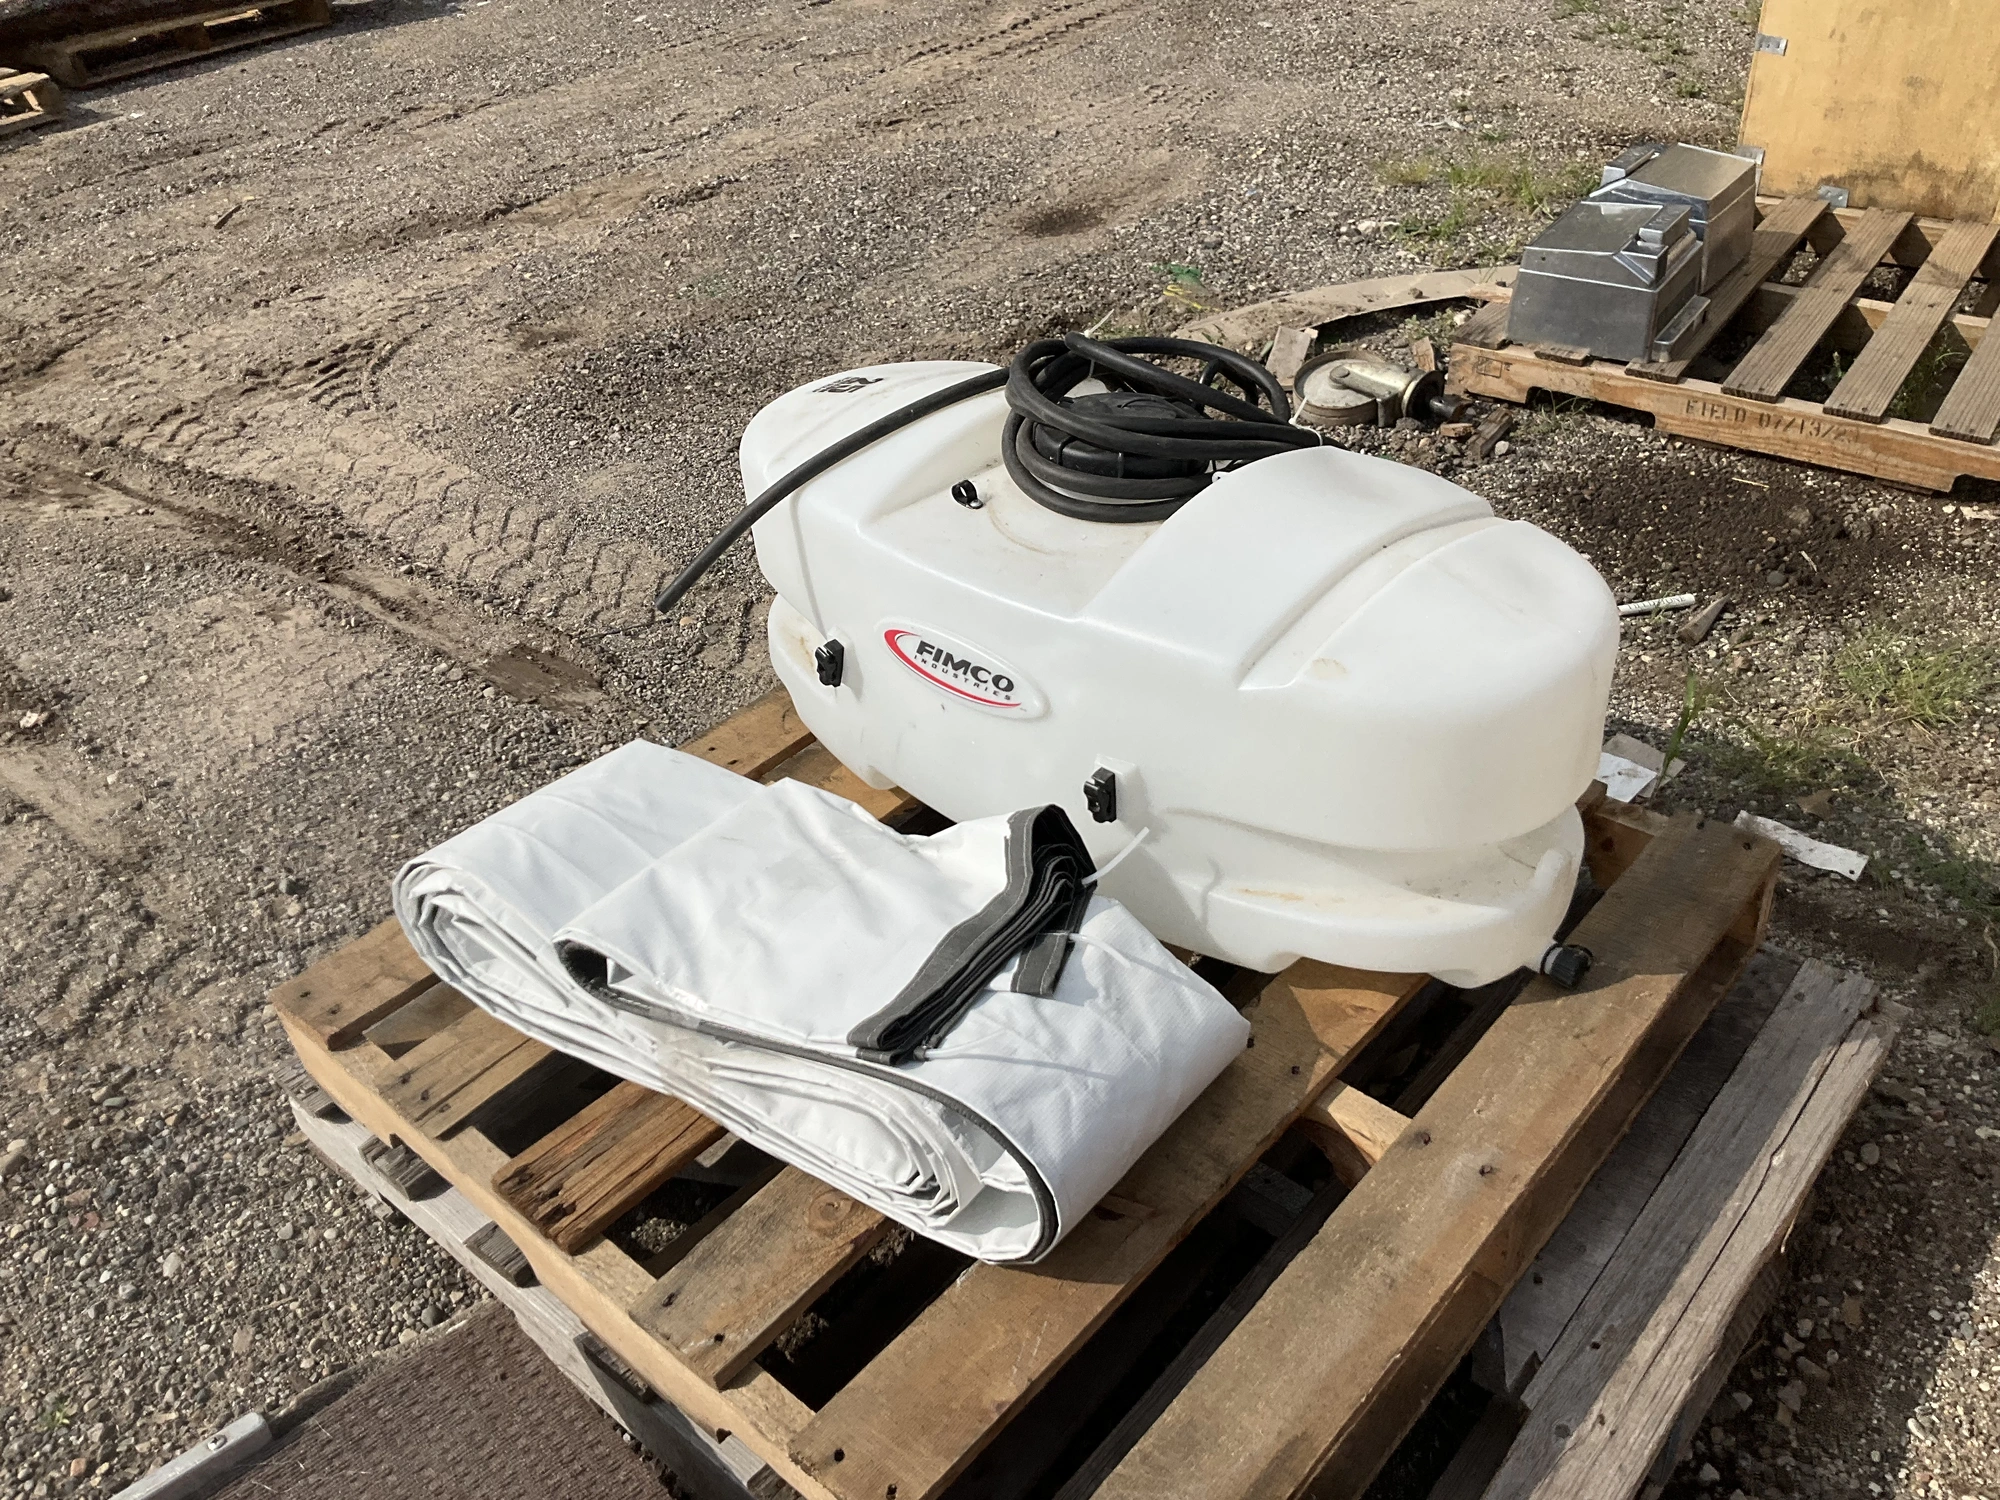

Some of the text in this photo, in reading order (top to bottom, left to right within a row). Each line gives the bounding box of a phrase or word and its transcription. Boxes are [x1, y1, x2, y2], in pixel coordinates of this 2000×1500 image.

[1685, 399, 1747, 424] FIELD
[914, 655, 1011, 701] INDUSTRIES
[916, 640, 1015, 692] FIMCO
